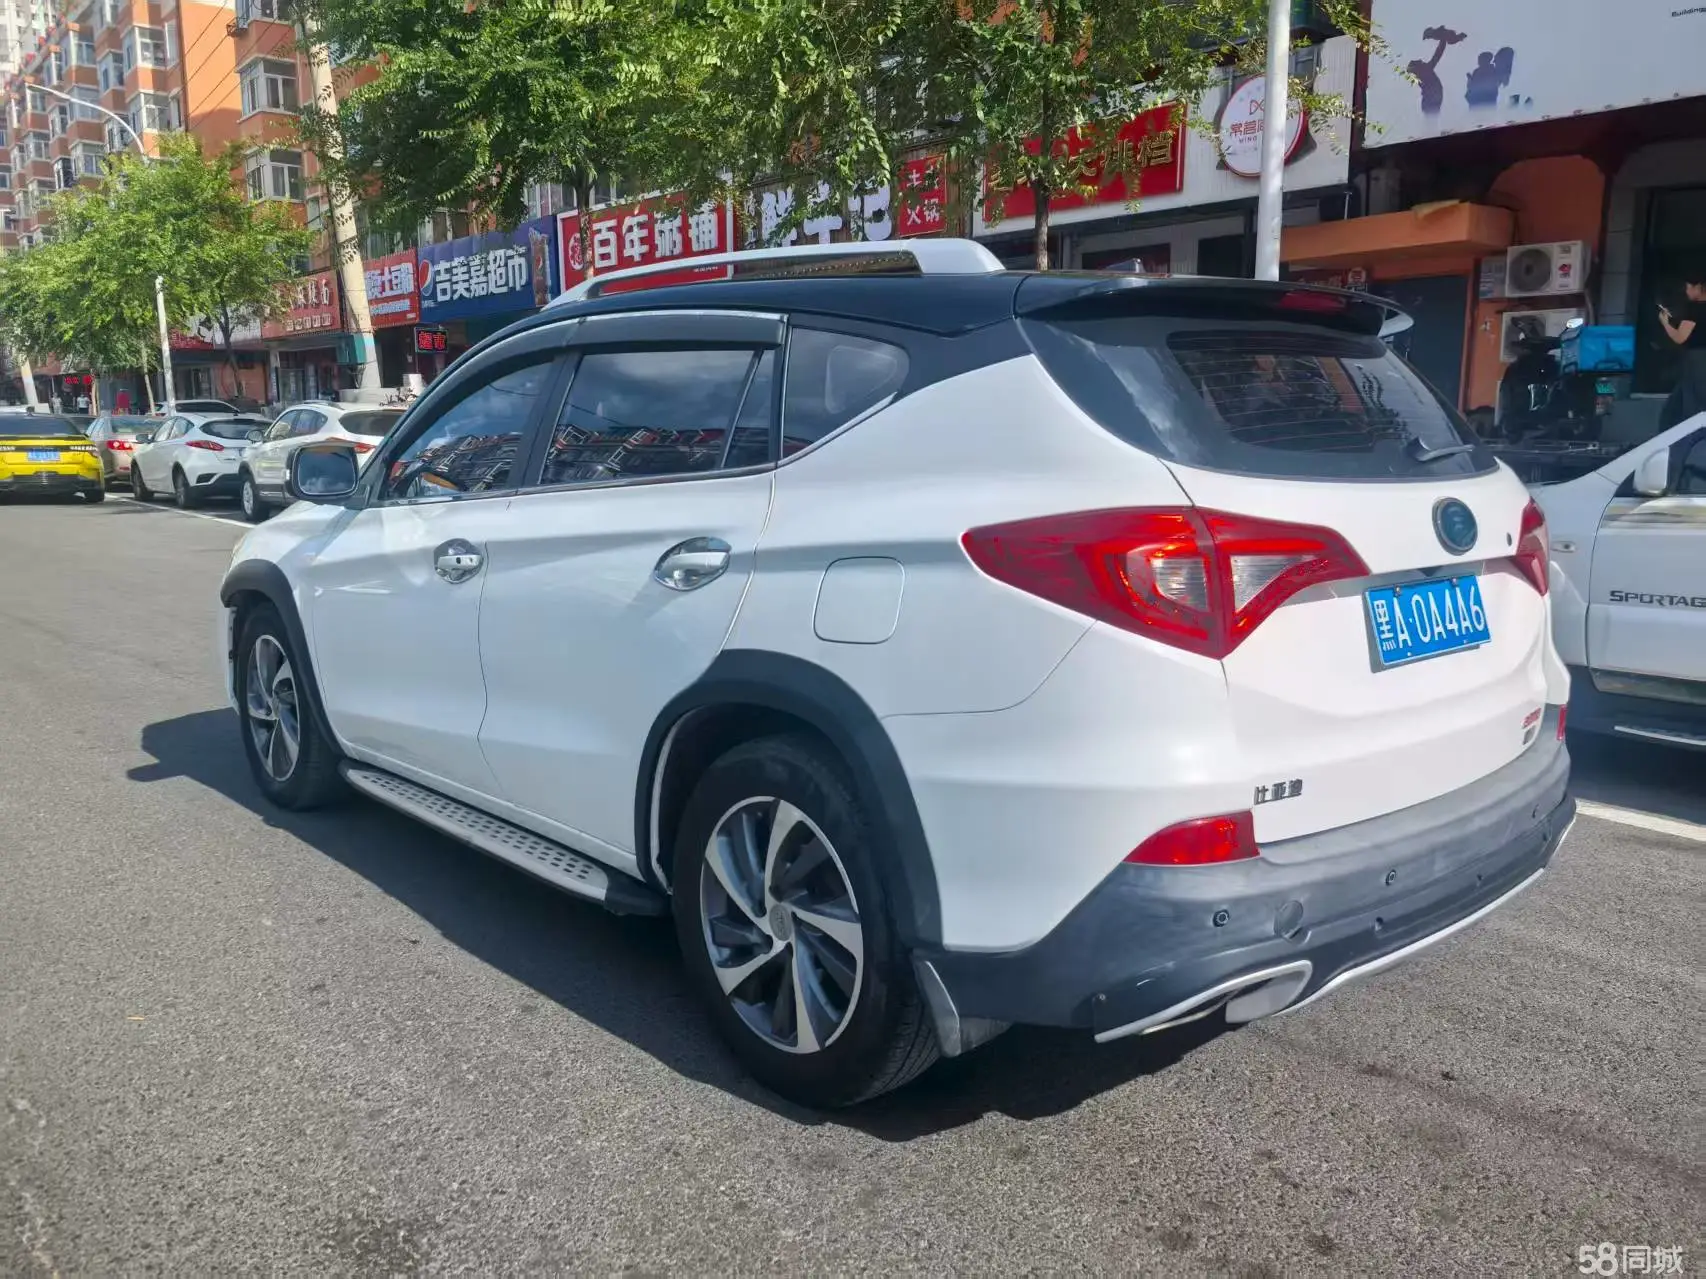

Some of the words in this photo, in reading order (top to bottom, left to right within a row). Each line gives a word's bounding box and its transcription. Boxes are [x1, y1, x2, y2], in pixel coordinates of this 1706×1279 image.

[906, 199, 940, 225] 火锅
[434, 246, 528, 302] 吉美嘉超市
[1609, 590, 1706, 607] SPORTAG
